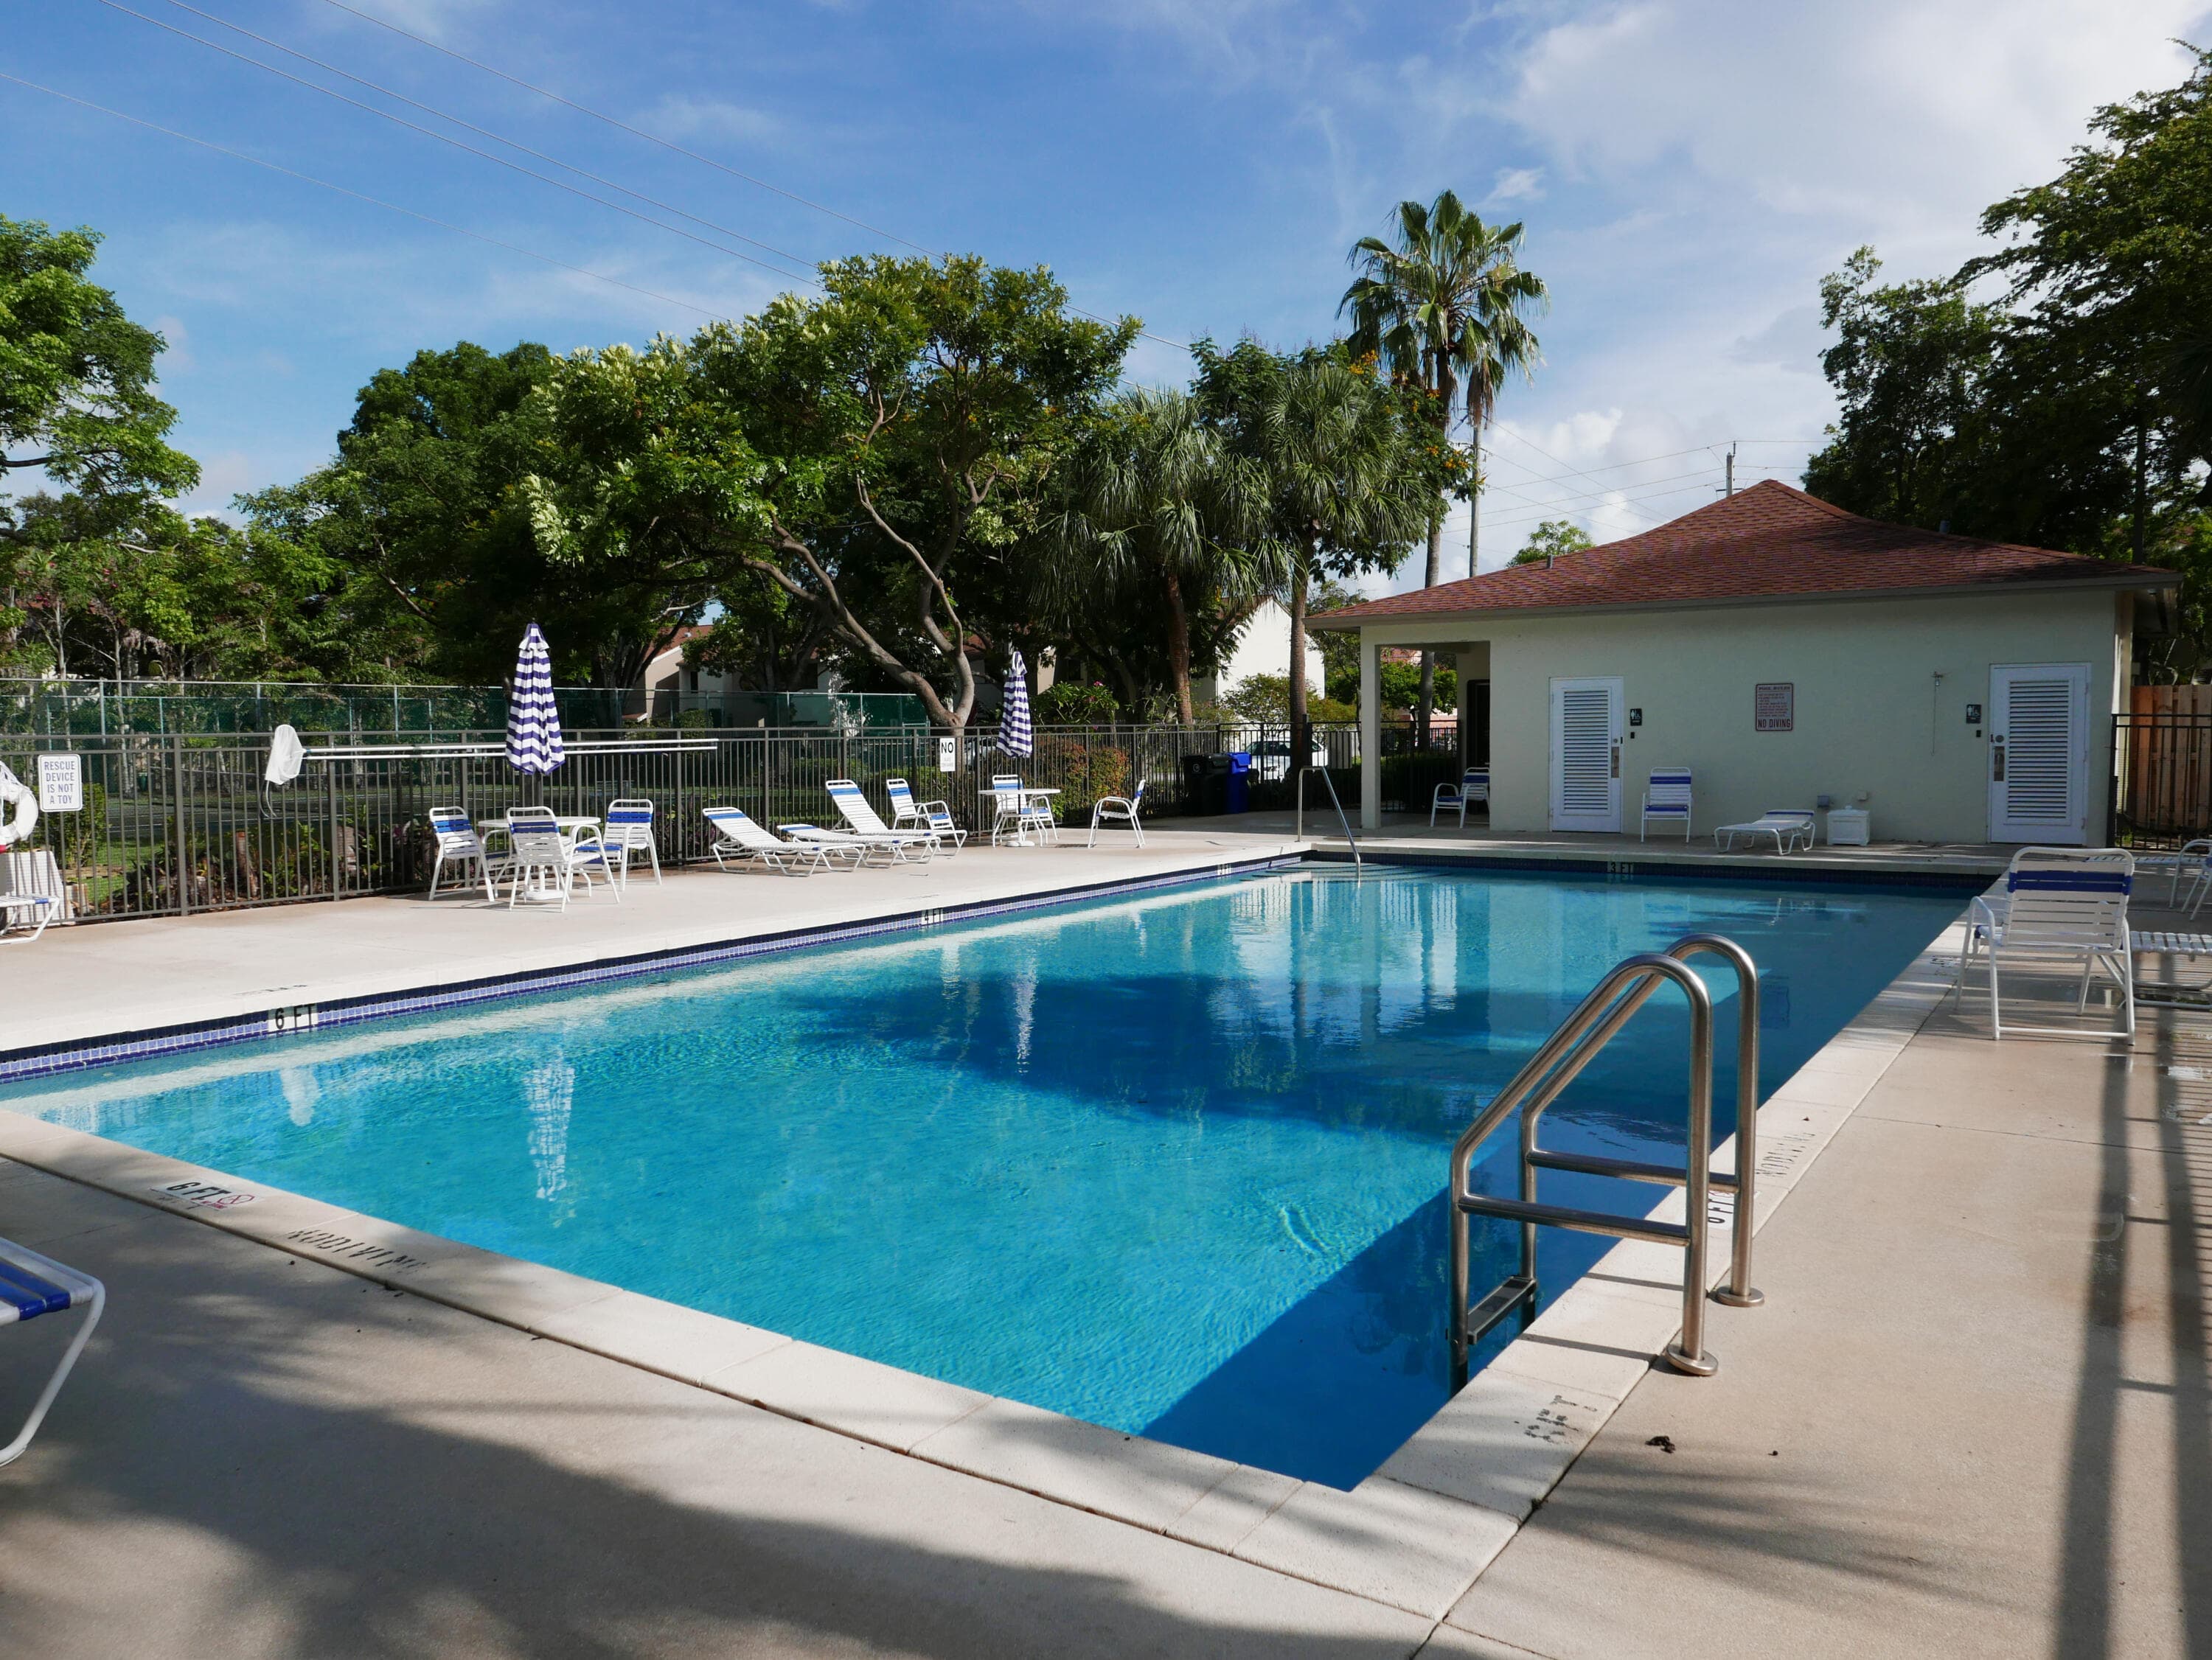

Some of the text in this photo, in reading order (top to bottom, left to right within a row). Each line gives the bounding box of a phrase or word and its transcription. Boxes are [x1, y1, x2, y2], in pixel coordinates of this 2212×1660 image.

[1758, 719, 1791, 728] NO DIVING
[941, 742, 954, 753] NO
[44, 761, 75, 770] RESCUE
[46, 772, 75, 781] DEVICE
[47, 784, 74, 793] IS NOT
[49, 795, 72, 804] A TOY
[1610, 861, 1633, 873] 3 FT
[925, 910, 929, 925] 4
[275, 1003, 316, 1030] 6 FT
[167, 1182, 232, 1201] 6 FT
